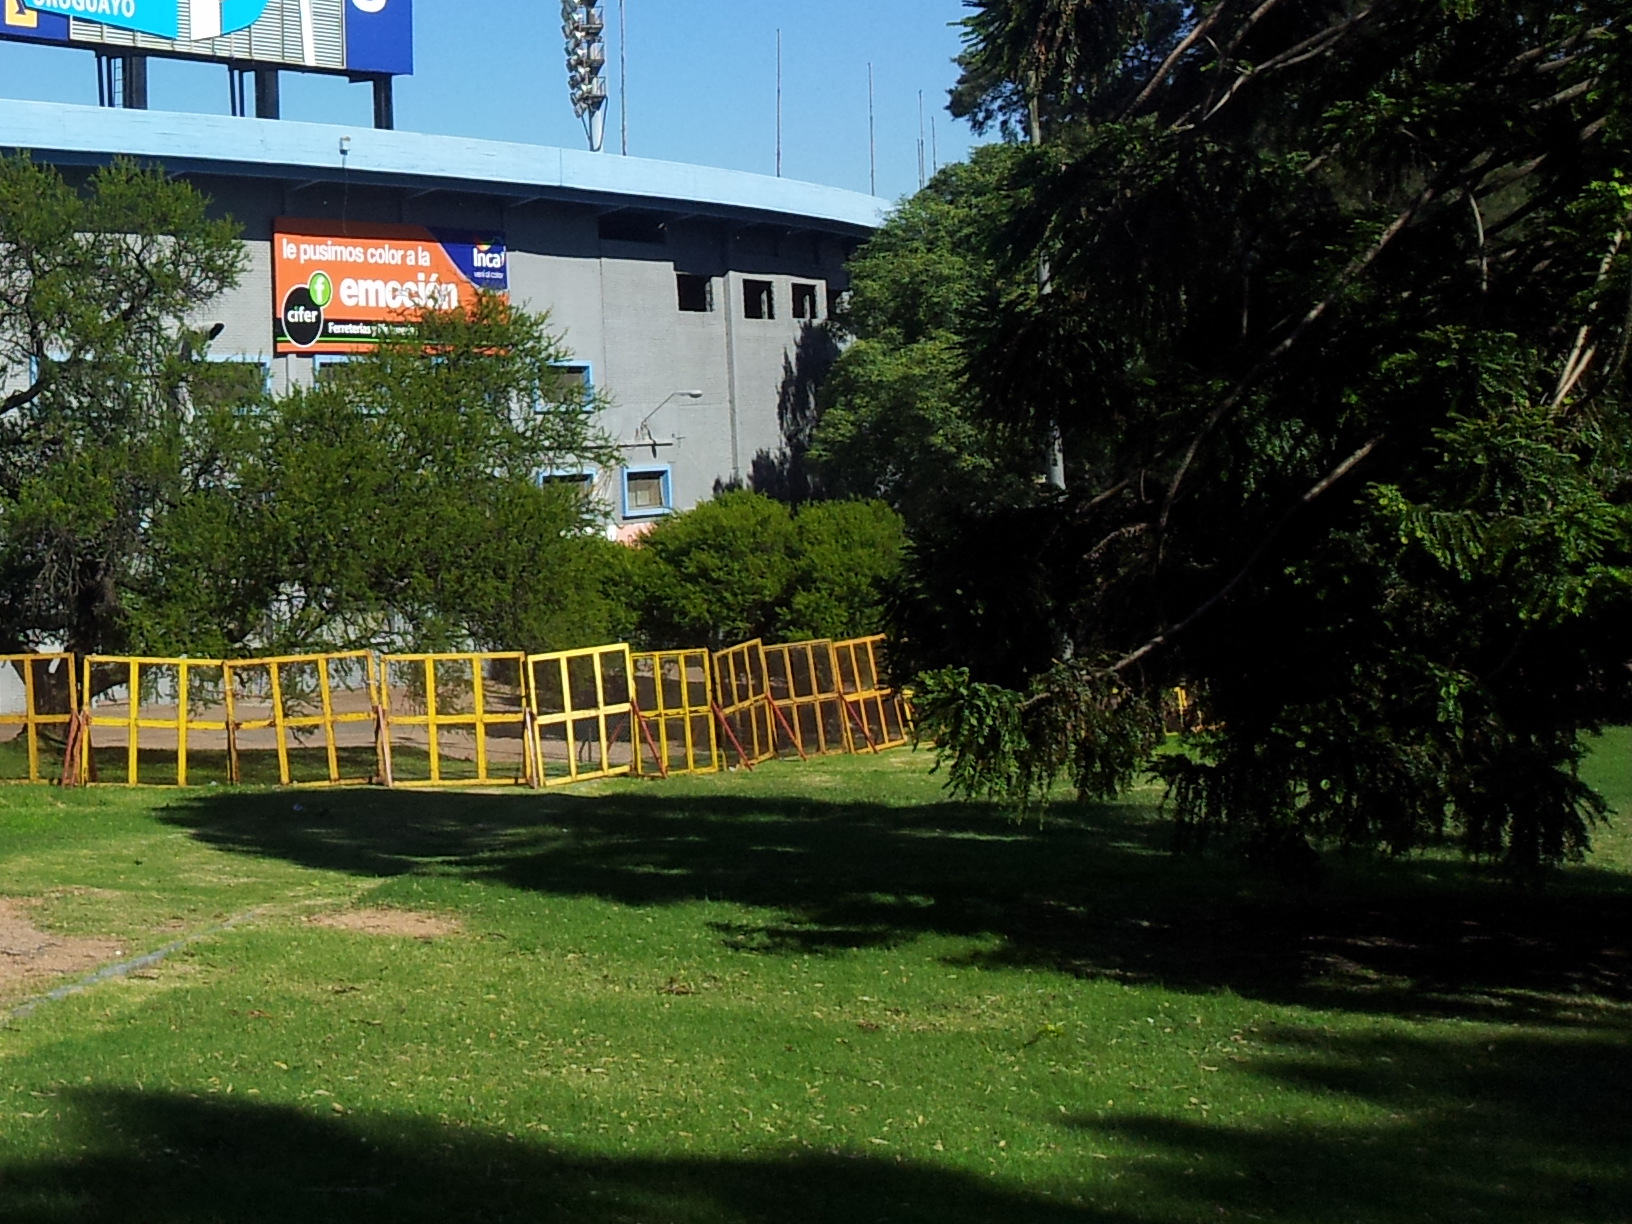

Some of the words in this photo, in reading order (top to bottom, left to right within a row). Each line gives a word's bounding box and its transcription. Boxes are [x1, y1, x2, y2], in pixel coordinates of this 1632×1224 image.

[282, 238, 297, 259] le
[300, 240, 364, 264] pusimos
[367, 244, 404, 265] color
[406, 251, 415, 266] a
[418, 246, 431, 267] la
[339, 272, 459, 310] emoción
[287, 305, 318, 323] cifer
